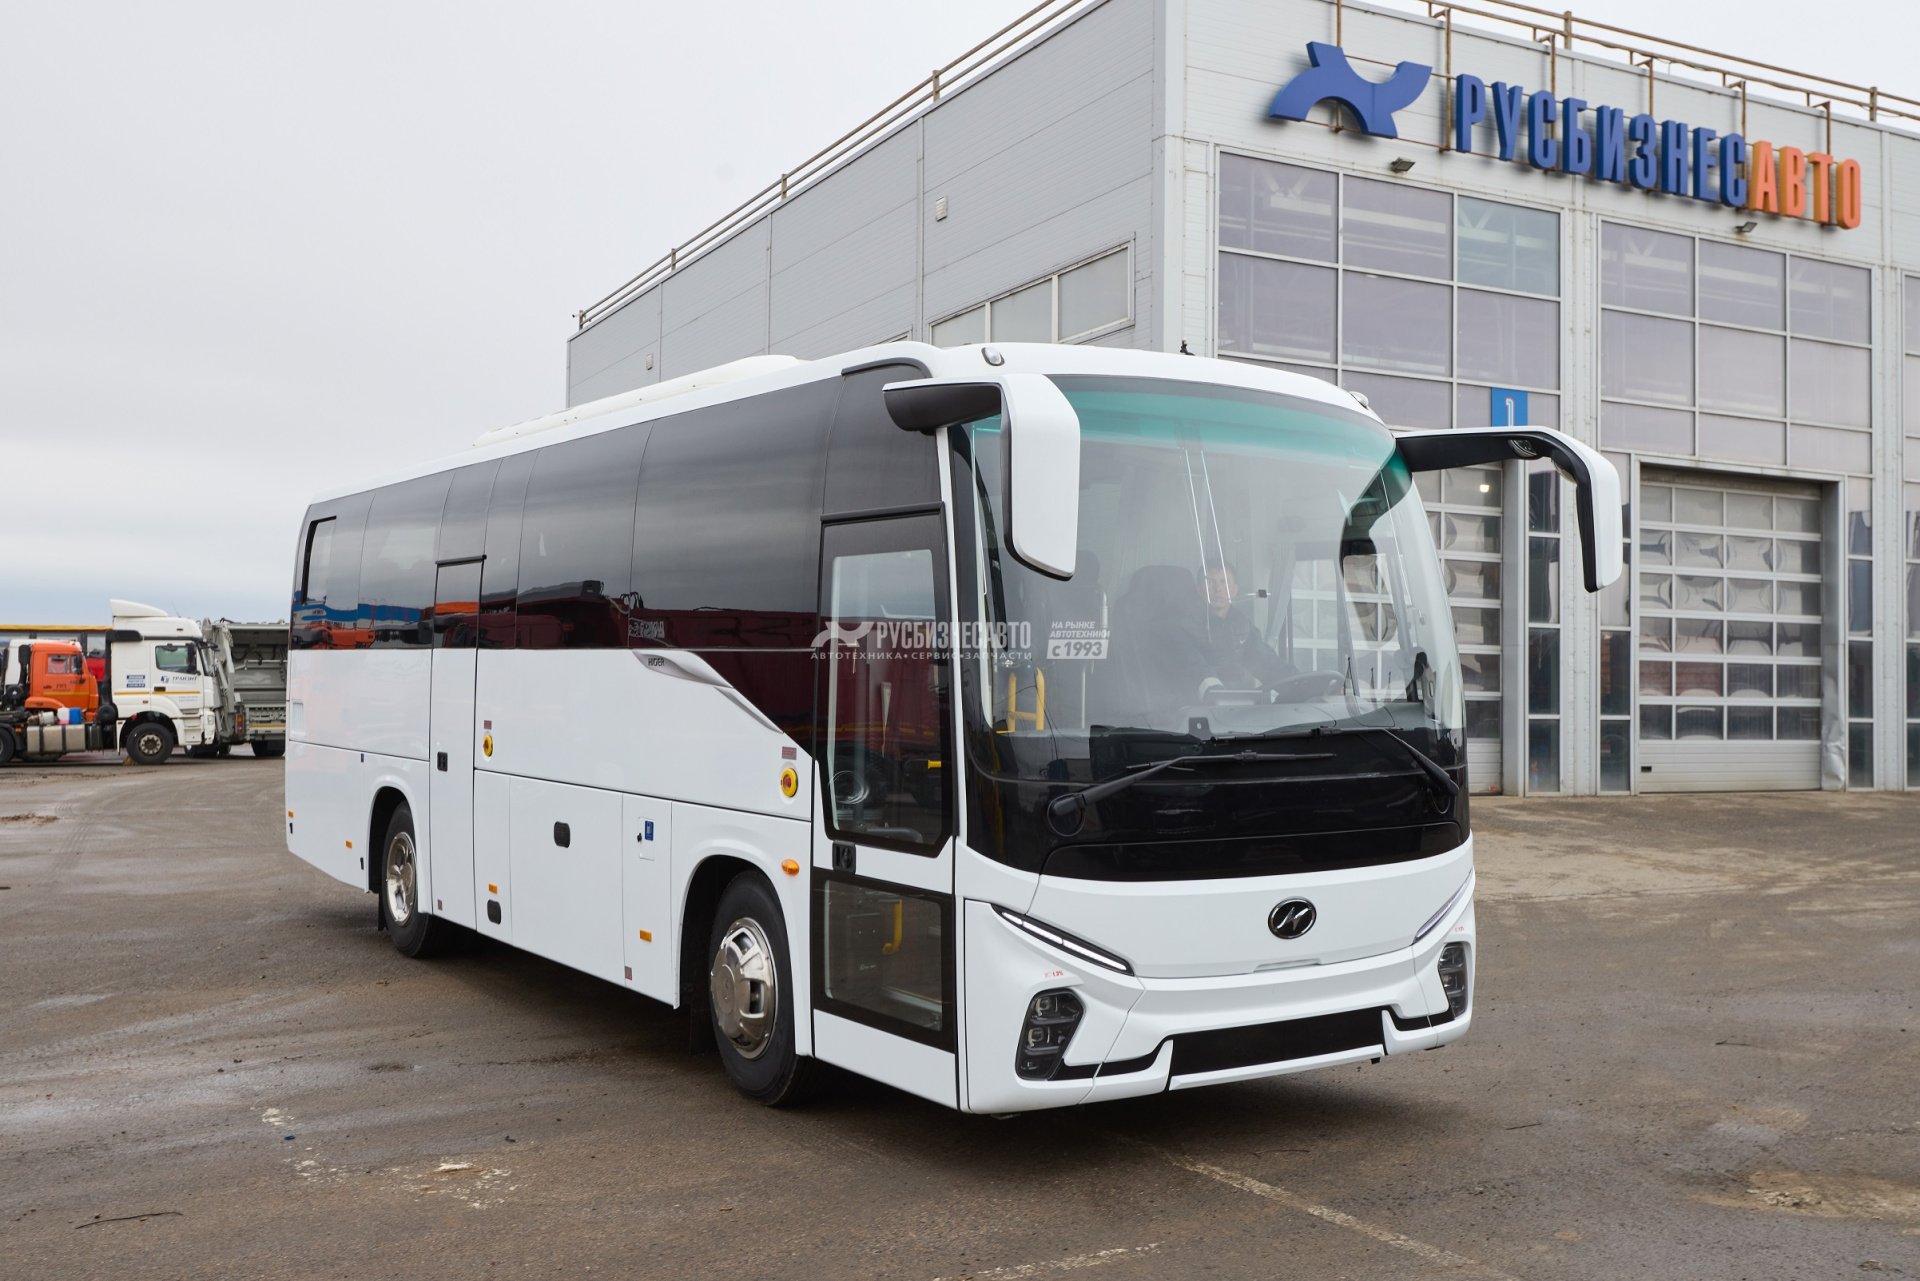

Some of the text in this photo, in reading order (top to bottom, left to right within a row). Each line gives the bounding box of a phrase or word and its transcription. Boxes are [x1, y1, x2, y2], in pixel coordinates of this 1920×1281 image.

[1456, 73, 1861, 230] РУСБИЗНЕСАВТО
[1505, 397, 1514, 427] 1
[647, 657, 665, 667] HIGER
